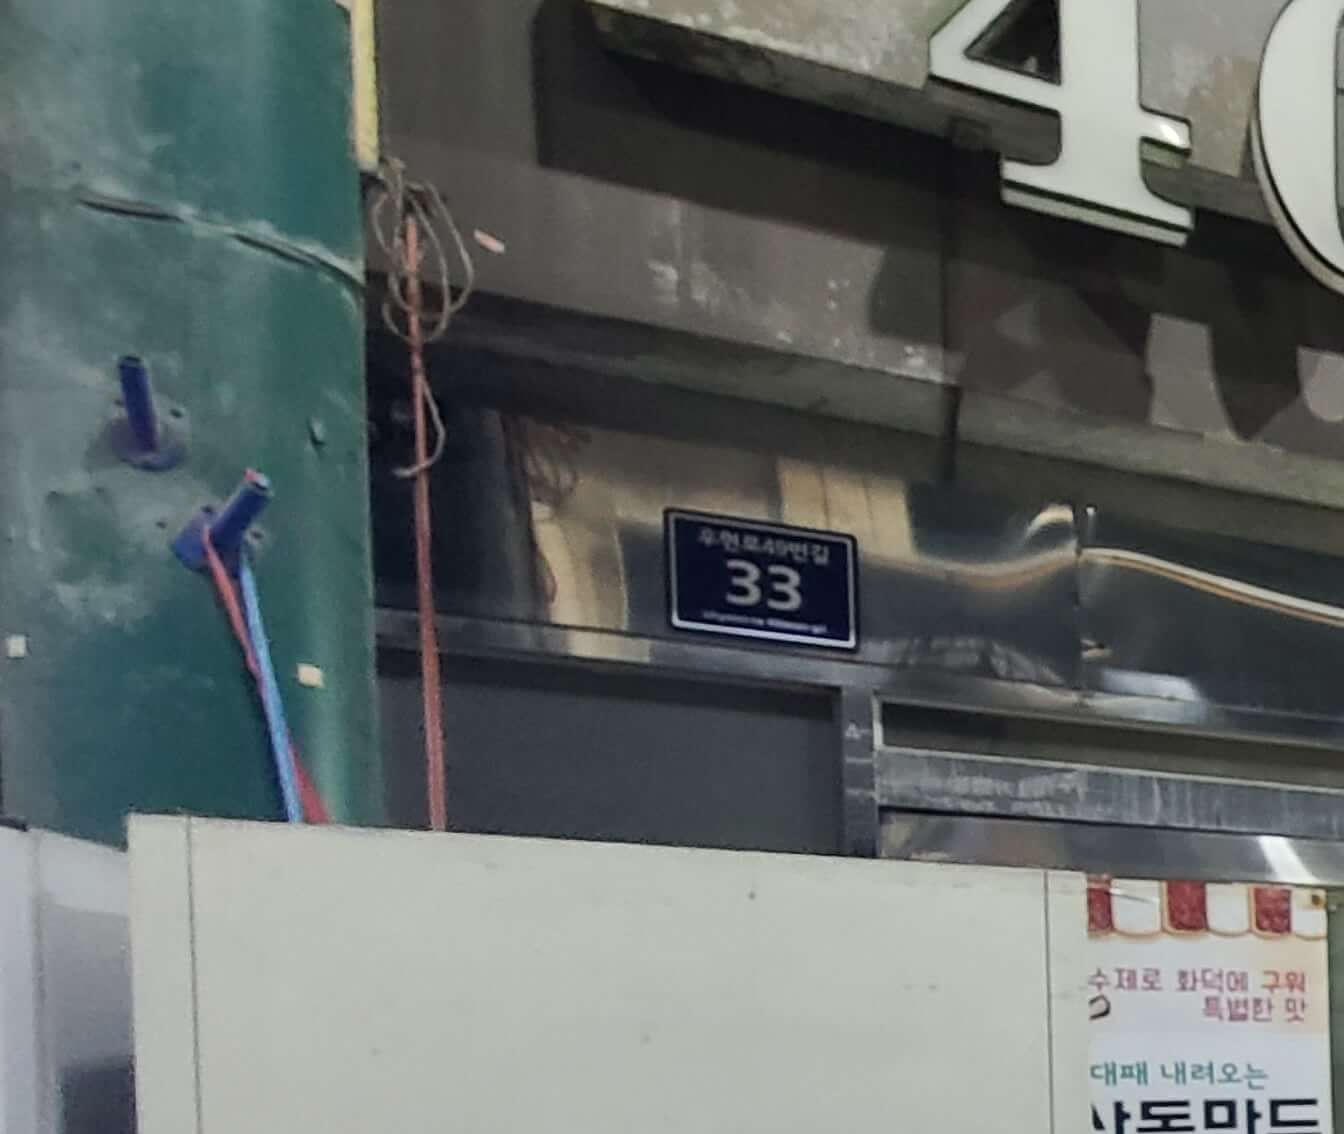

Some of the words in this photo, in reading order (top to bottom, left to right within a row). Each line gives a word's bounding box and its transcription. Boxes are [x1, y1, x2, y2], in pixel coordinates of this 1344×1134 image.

[725, 558, 802, 612] 33
[1089, 967, 1162, 991] 수제로
[1176, 968, 1249, 993] 화덕에
[1261, 970, 1306, 994] 구워
[1203, 996, 1274, 1022] 특별한
[1160, 1060, 1268, 1090] 내려오는
